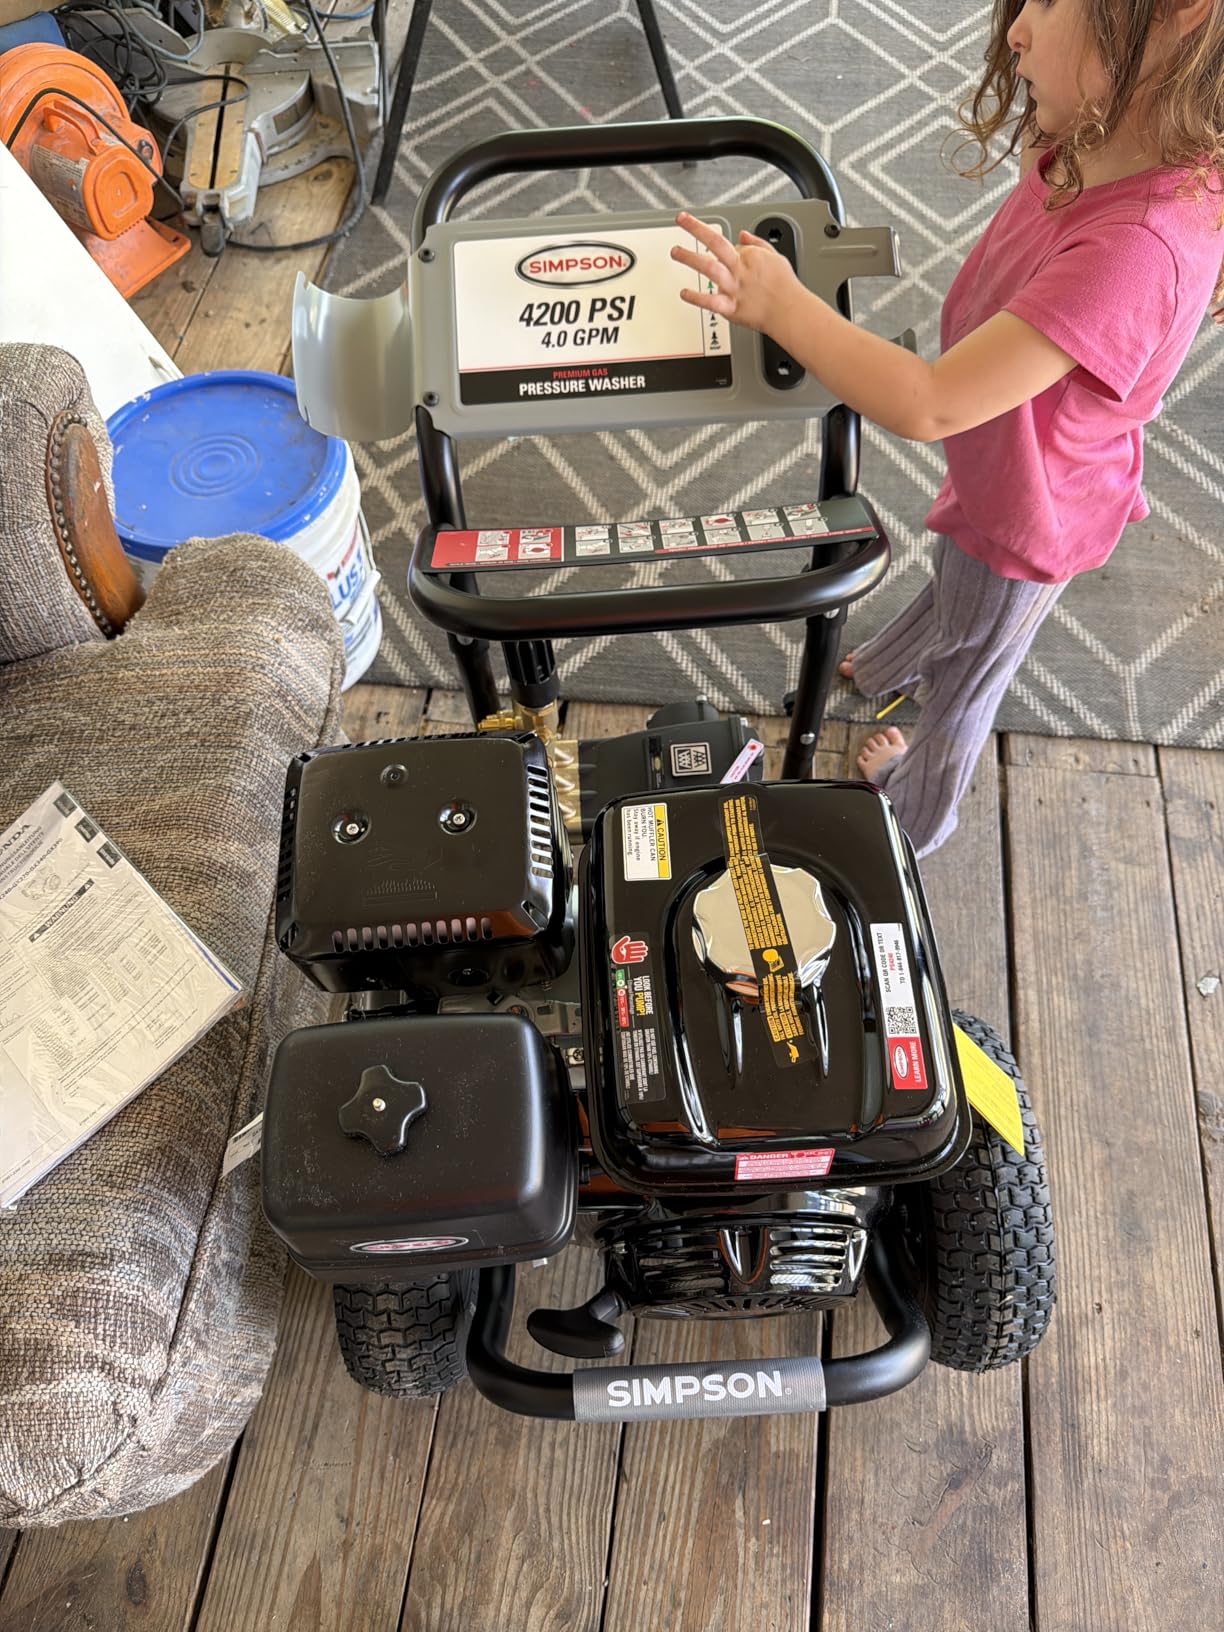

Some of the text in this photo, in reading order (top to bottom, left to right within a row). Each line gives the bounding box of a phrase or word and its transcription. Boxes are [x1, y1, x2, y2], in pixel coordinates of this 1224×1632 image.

[528, 254, 624, 274] SIMPSON
[519, 295, 636, 327] 4200 PSI
[541, 327, 619, 348] 4.0 GPM
[519, 376, 646, 396] PRESSURE WASHER
[553, 368, 608, 379] PREMIUM GAS
[657, 828, 666, 861] CAUTION
[633, 976, 646, 1016] YOU PUMP!
[642, 975, 653, 1015] LOOK BEFORE
[910, 1042, 921, 1082] LEARN MORE
[606, 1370, 783, 1407] SIMPSON
